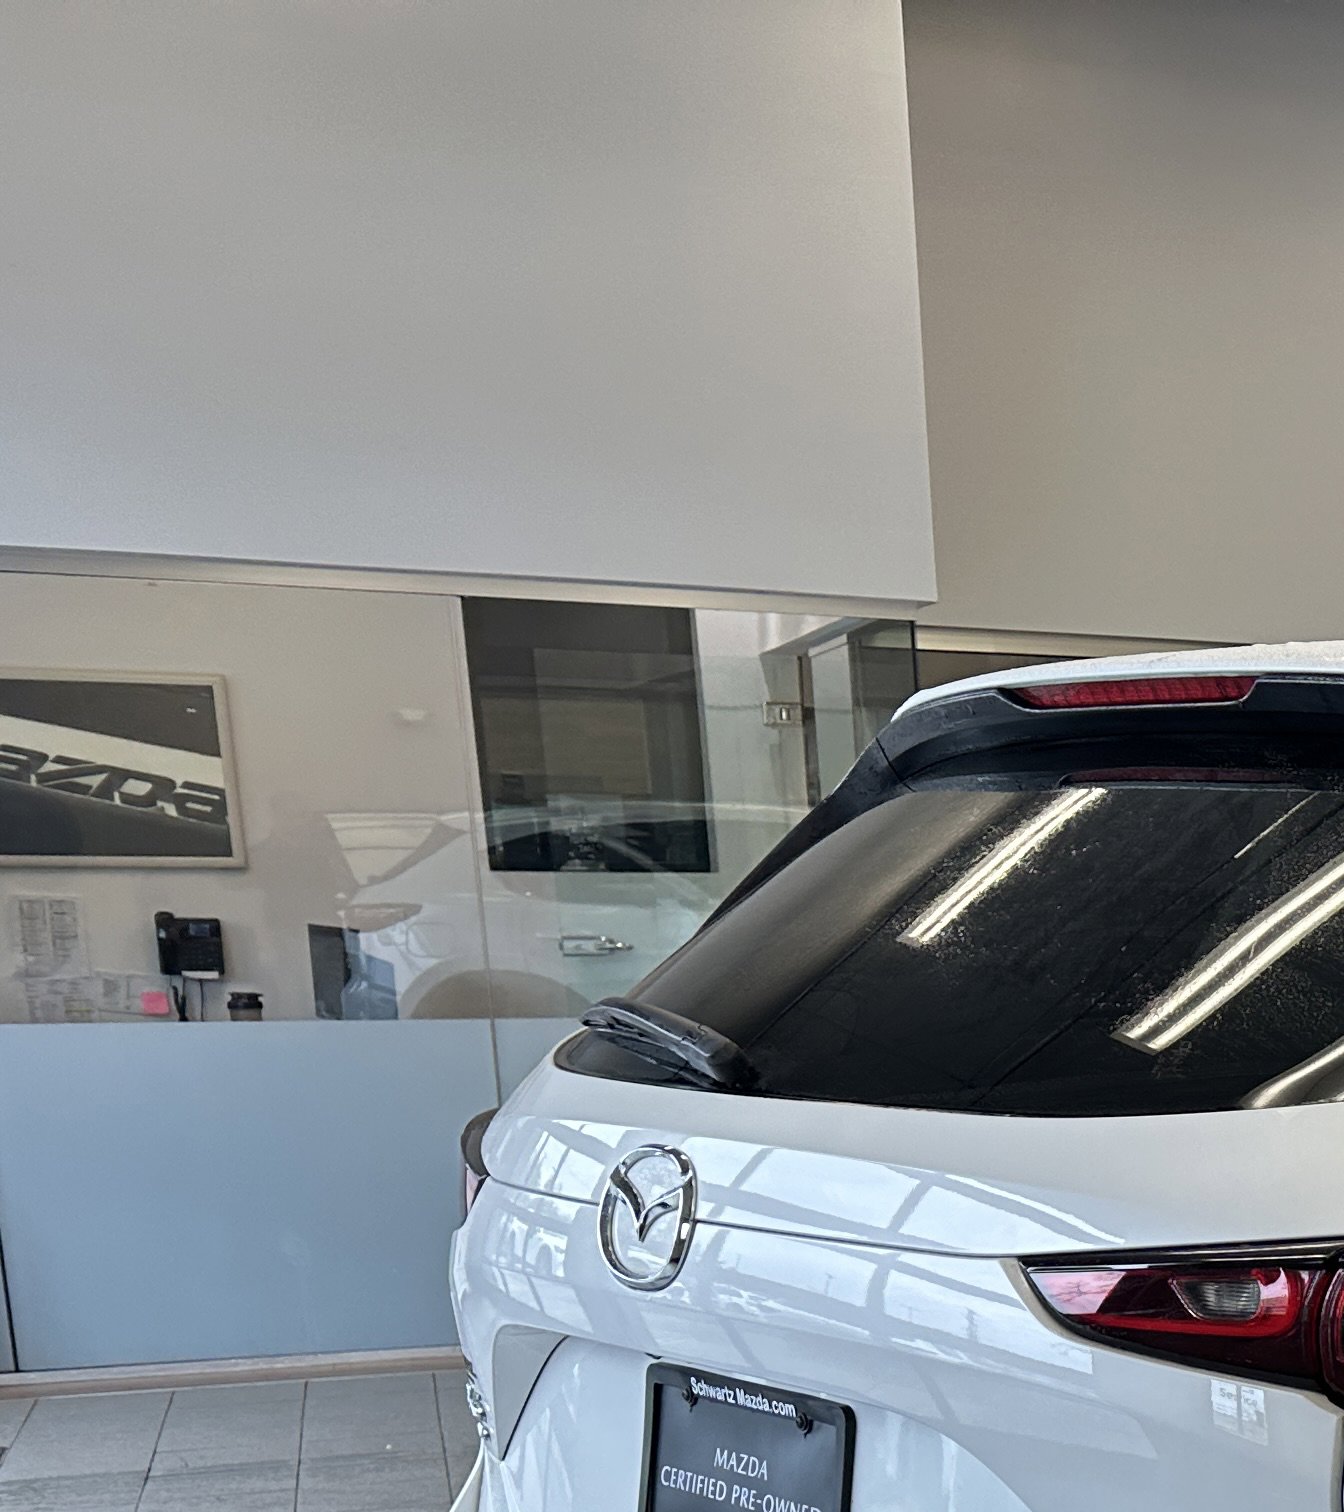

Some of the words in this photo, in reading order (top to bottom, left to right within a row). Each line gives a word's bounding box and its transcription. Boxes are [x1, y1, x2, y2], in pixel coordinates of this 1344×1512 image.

[0, 743, 228, 826] azda
[690, 1376, 736, 1404] Schwartz
[736, 1387, 796, 1418] Mazda.com
[660, 1465, 727, 1501] CERTIFIED
[713, 1447, 768, 1481] MAZDA
